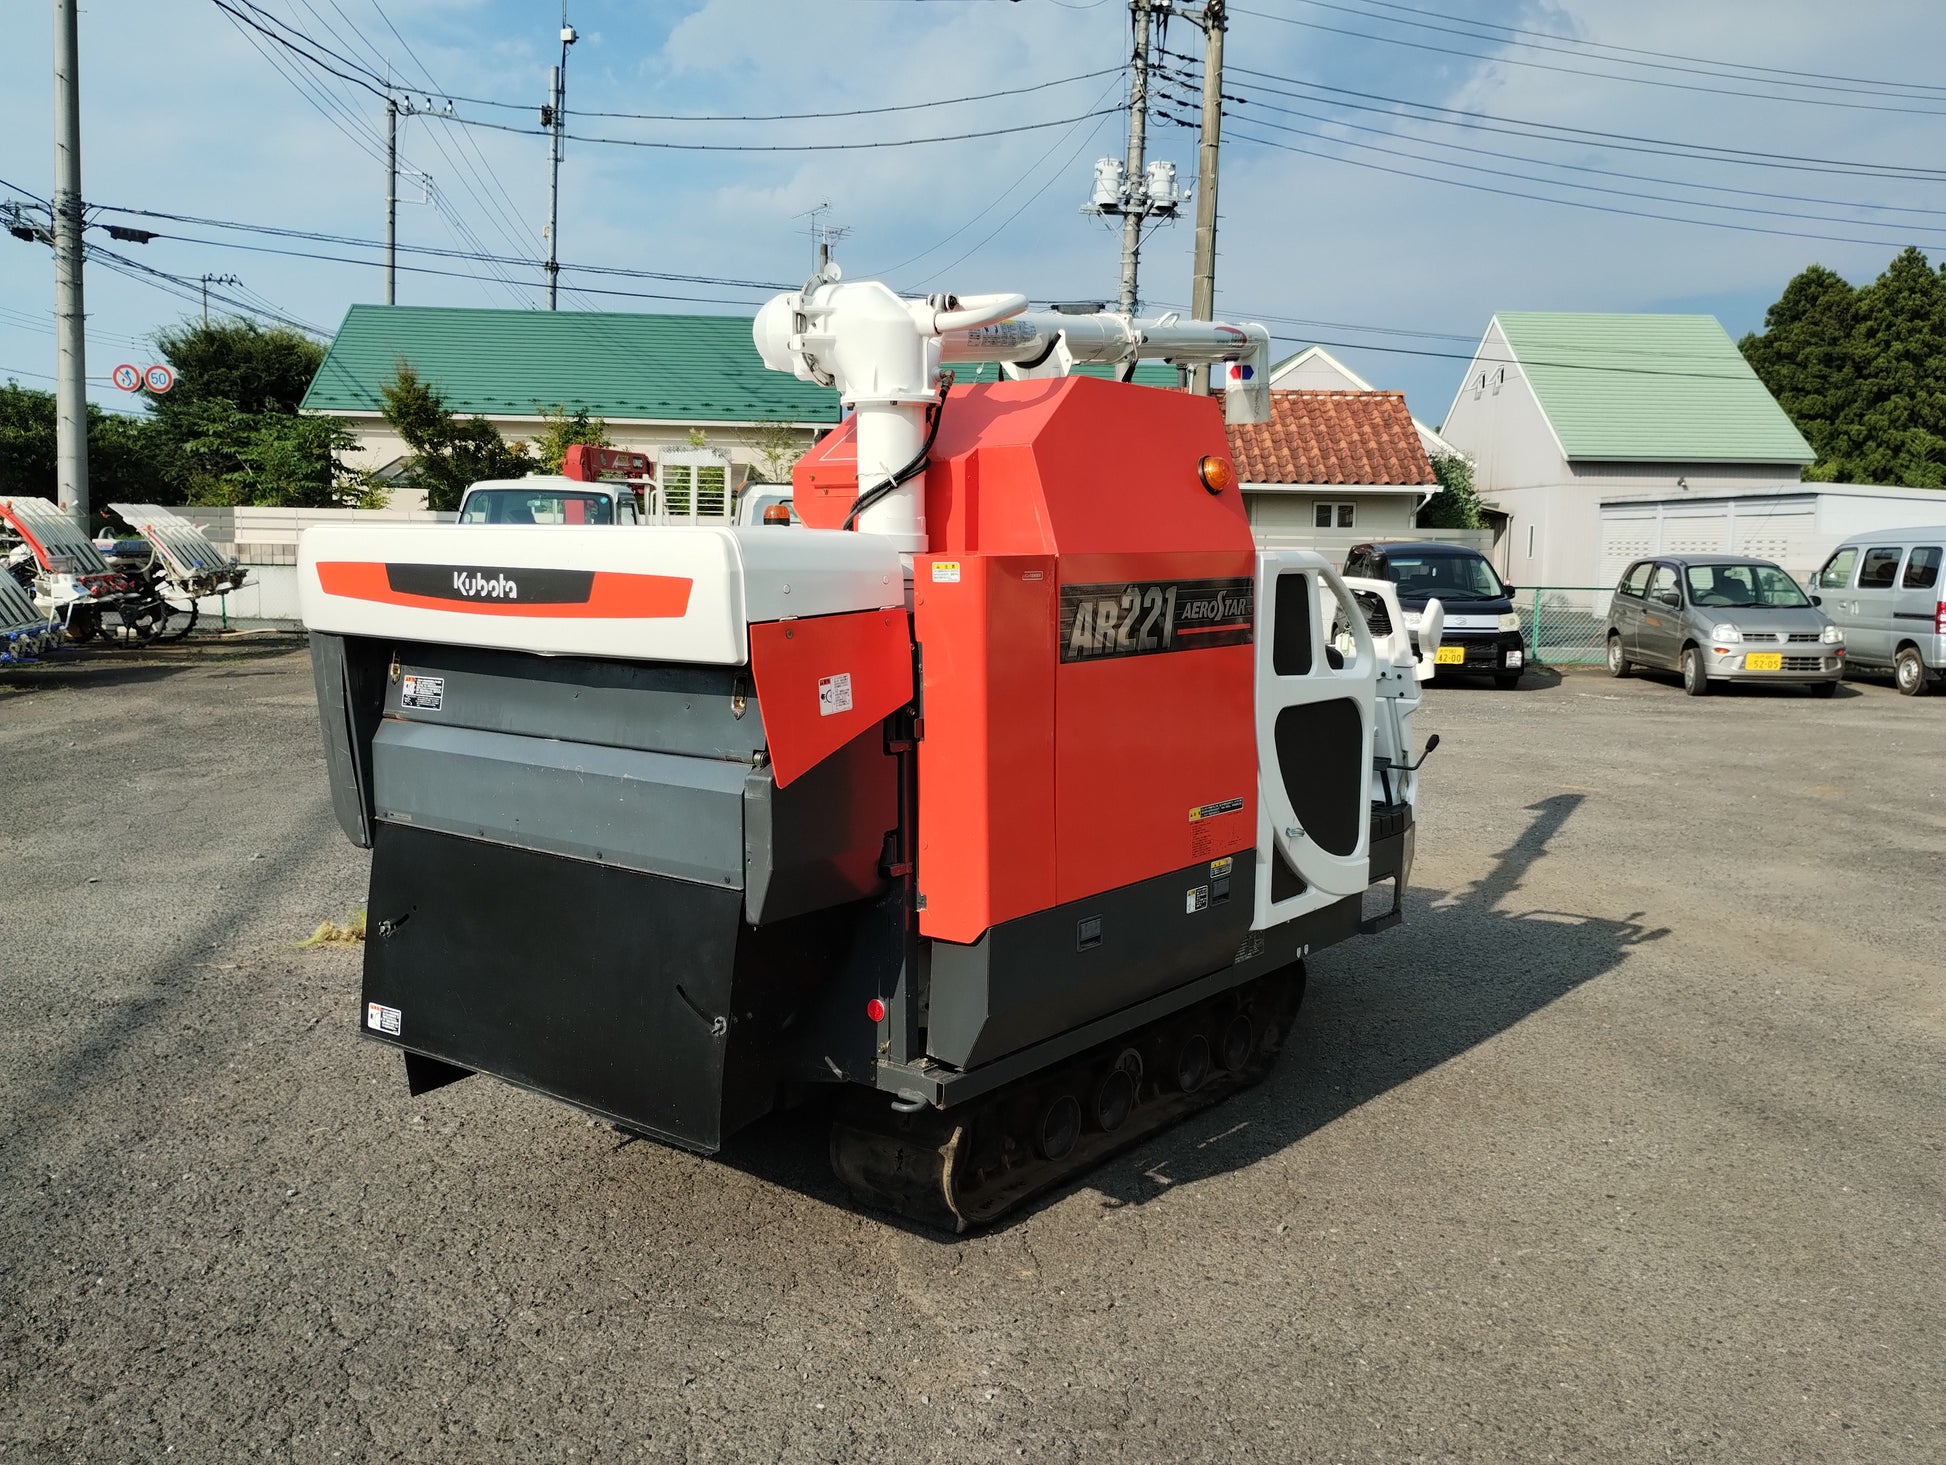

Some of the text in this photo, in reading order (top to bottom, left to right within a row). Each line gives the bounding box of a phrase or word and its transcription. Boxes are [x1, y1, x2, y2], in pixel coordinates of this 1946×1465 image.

[150, 372, 167, 385] 50
[453, 571, 518, 599] Kubota
[1066, 585, 1178, 658] AR221
